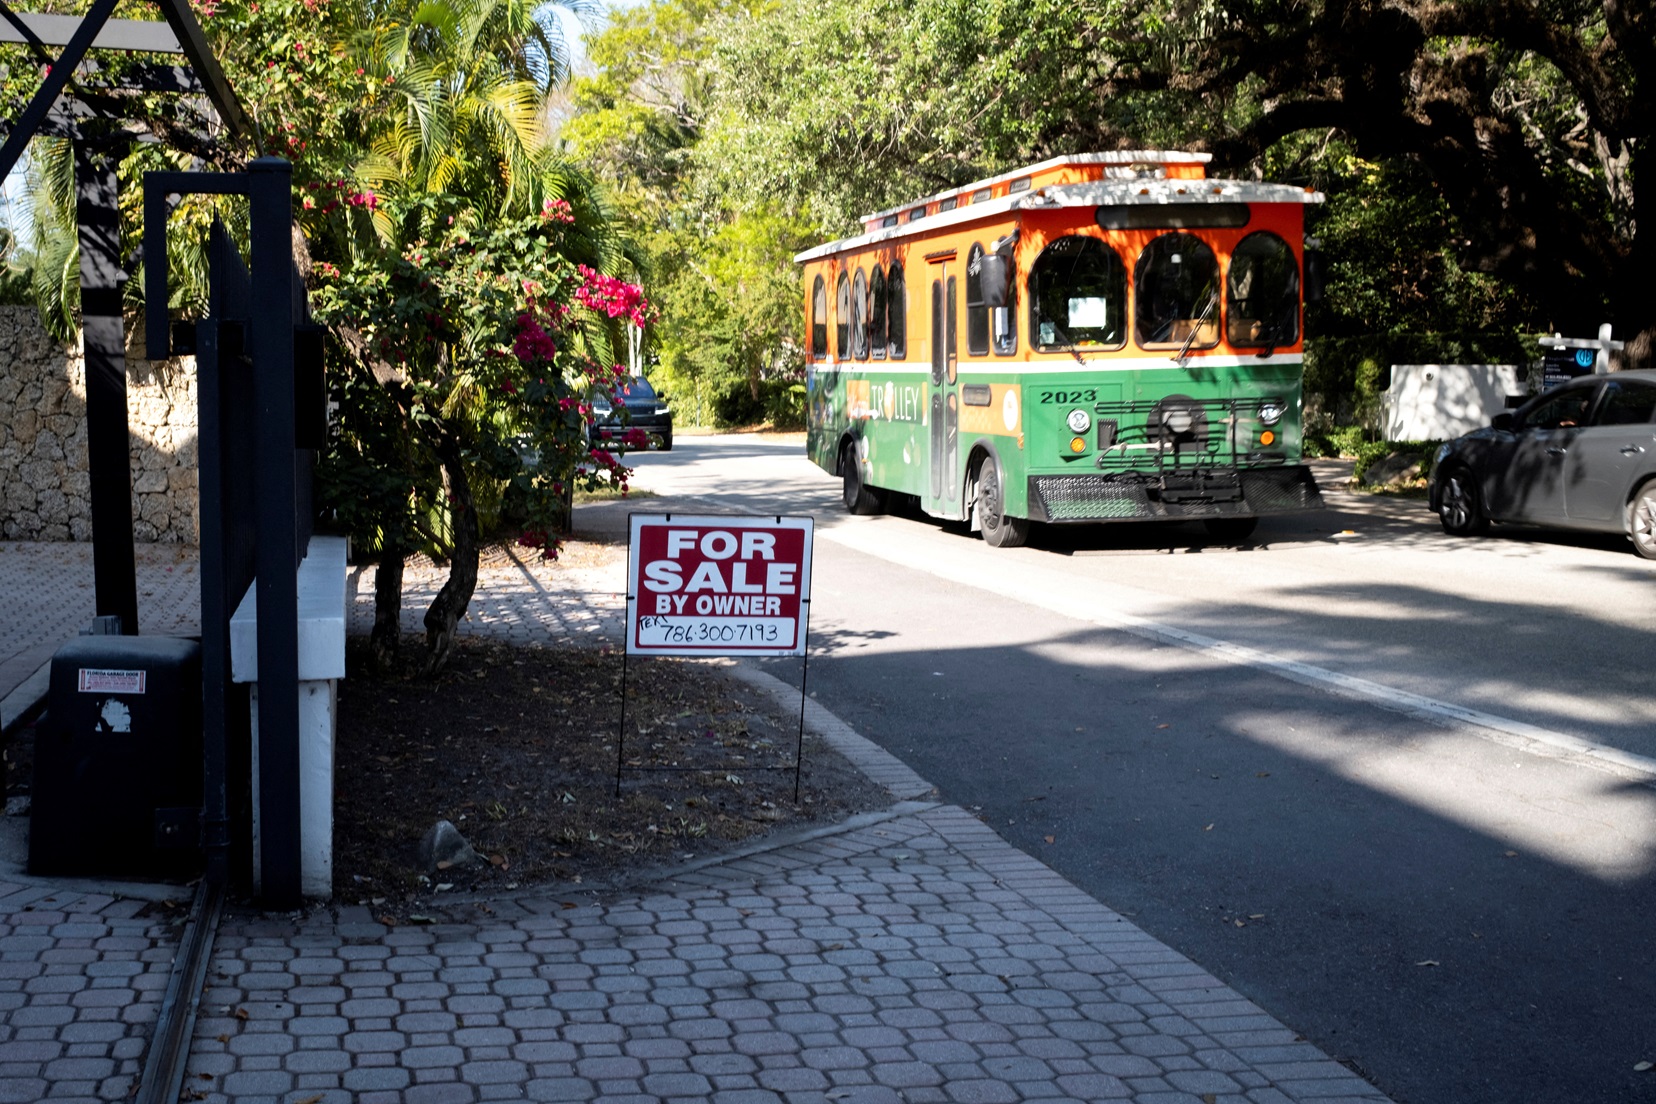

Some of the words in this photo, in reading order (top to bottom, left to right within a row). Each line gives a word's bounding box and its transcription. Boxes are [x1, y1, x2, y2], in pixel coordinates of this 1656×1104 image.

[871, 382, 920, 422] TROLLEY
[1040, 389, 1097, 404] 2023
[667, 530, 776, 560] FOR
[643, 560, 797, 594] SALE
[655, 594, 688, 615] BY
[695, 595, 781, 616] OWNER
[639, 614, 668, 631] TEXT
